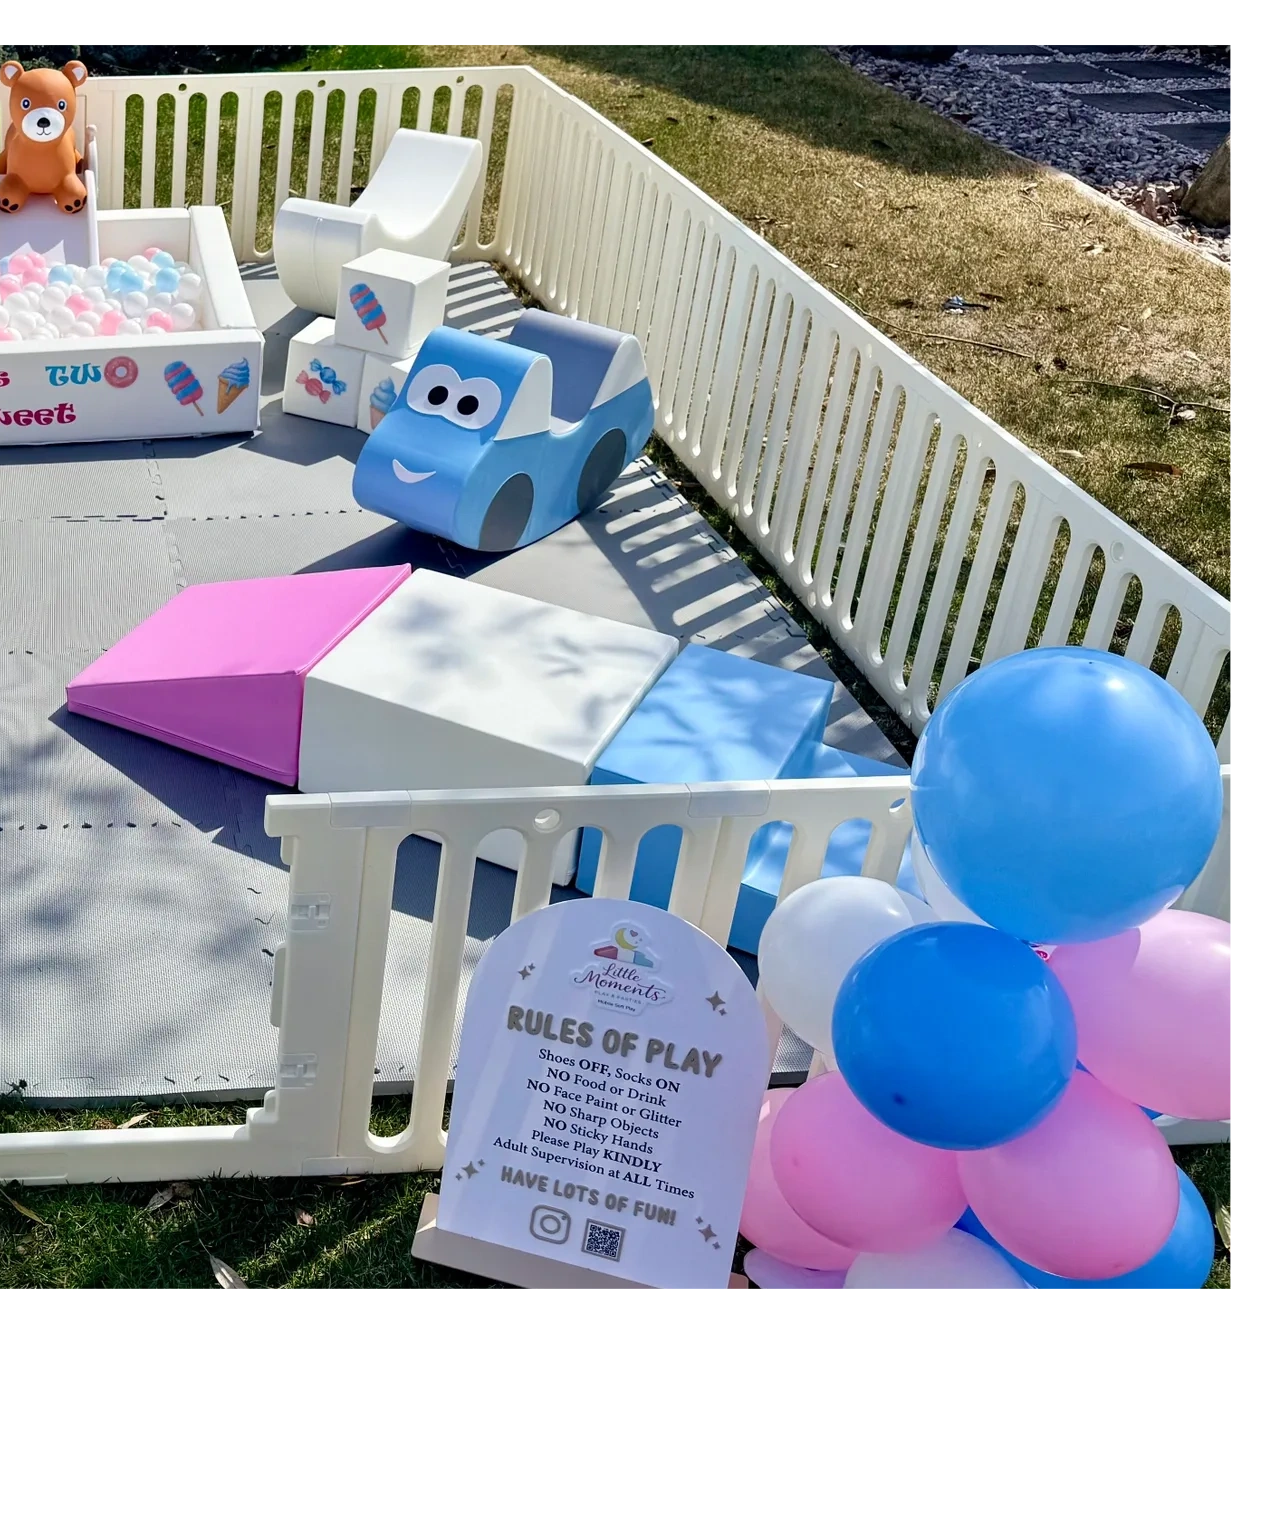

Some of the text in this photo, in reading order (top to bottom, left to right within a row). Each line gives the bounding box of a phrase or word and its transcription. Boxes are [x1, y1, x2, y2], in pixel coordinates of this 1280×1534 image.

[573, 970, 666, 1001] Moments
[602, 963, 641, 982] Little
[507, 1005, 723, 1078] RULES OF PLAY
[538, 1048, 681, 1094] Shoes OFF, Socks ON
[546, 1067, 666, 1107] NO Food or Drink
[526, 1078, 682, 1128] NO Face Paint or Glitter
[543, 1099, 659, 1139] NO Sharp Objects
[531, 1129, 662, 1173] Please Play KINDLY
[543, 1116, 653, 1154] NO Sticky Hands
[493, 1136, 695, 1199] Adult Supervision at ALL Times
[501, 1165, 677, 1226] HAVE LOTS OF FUN!
